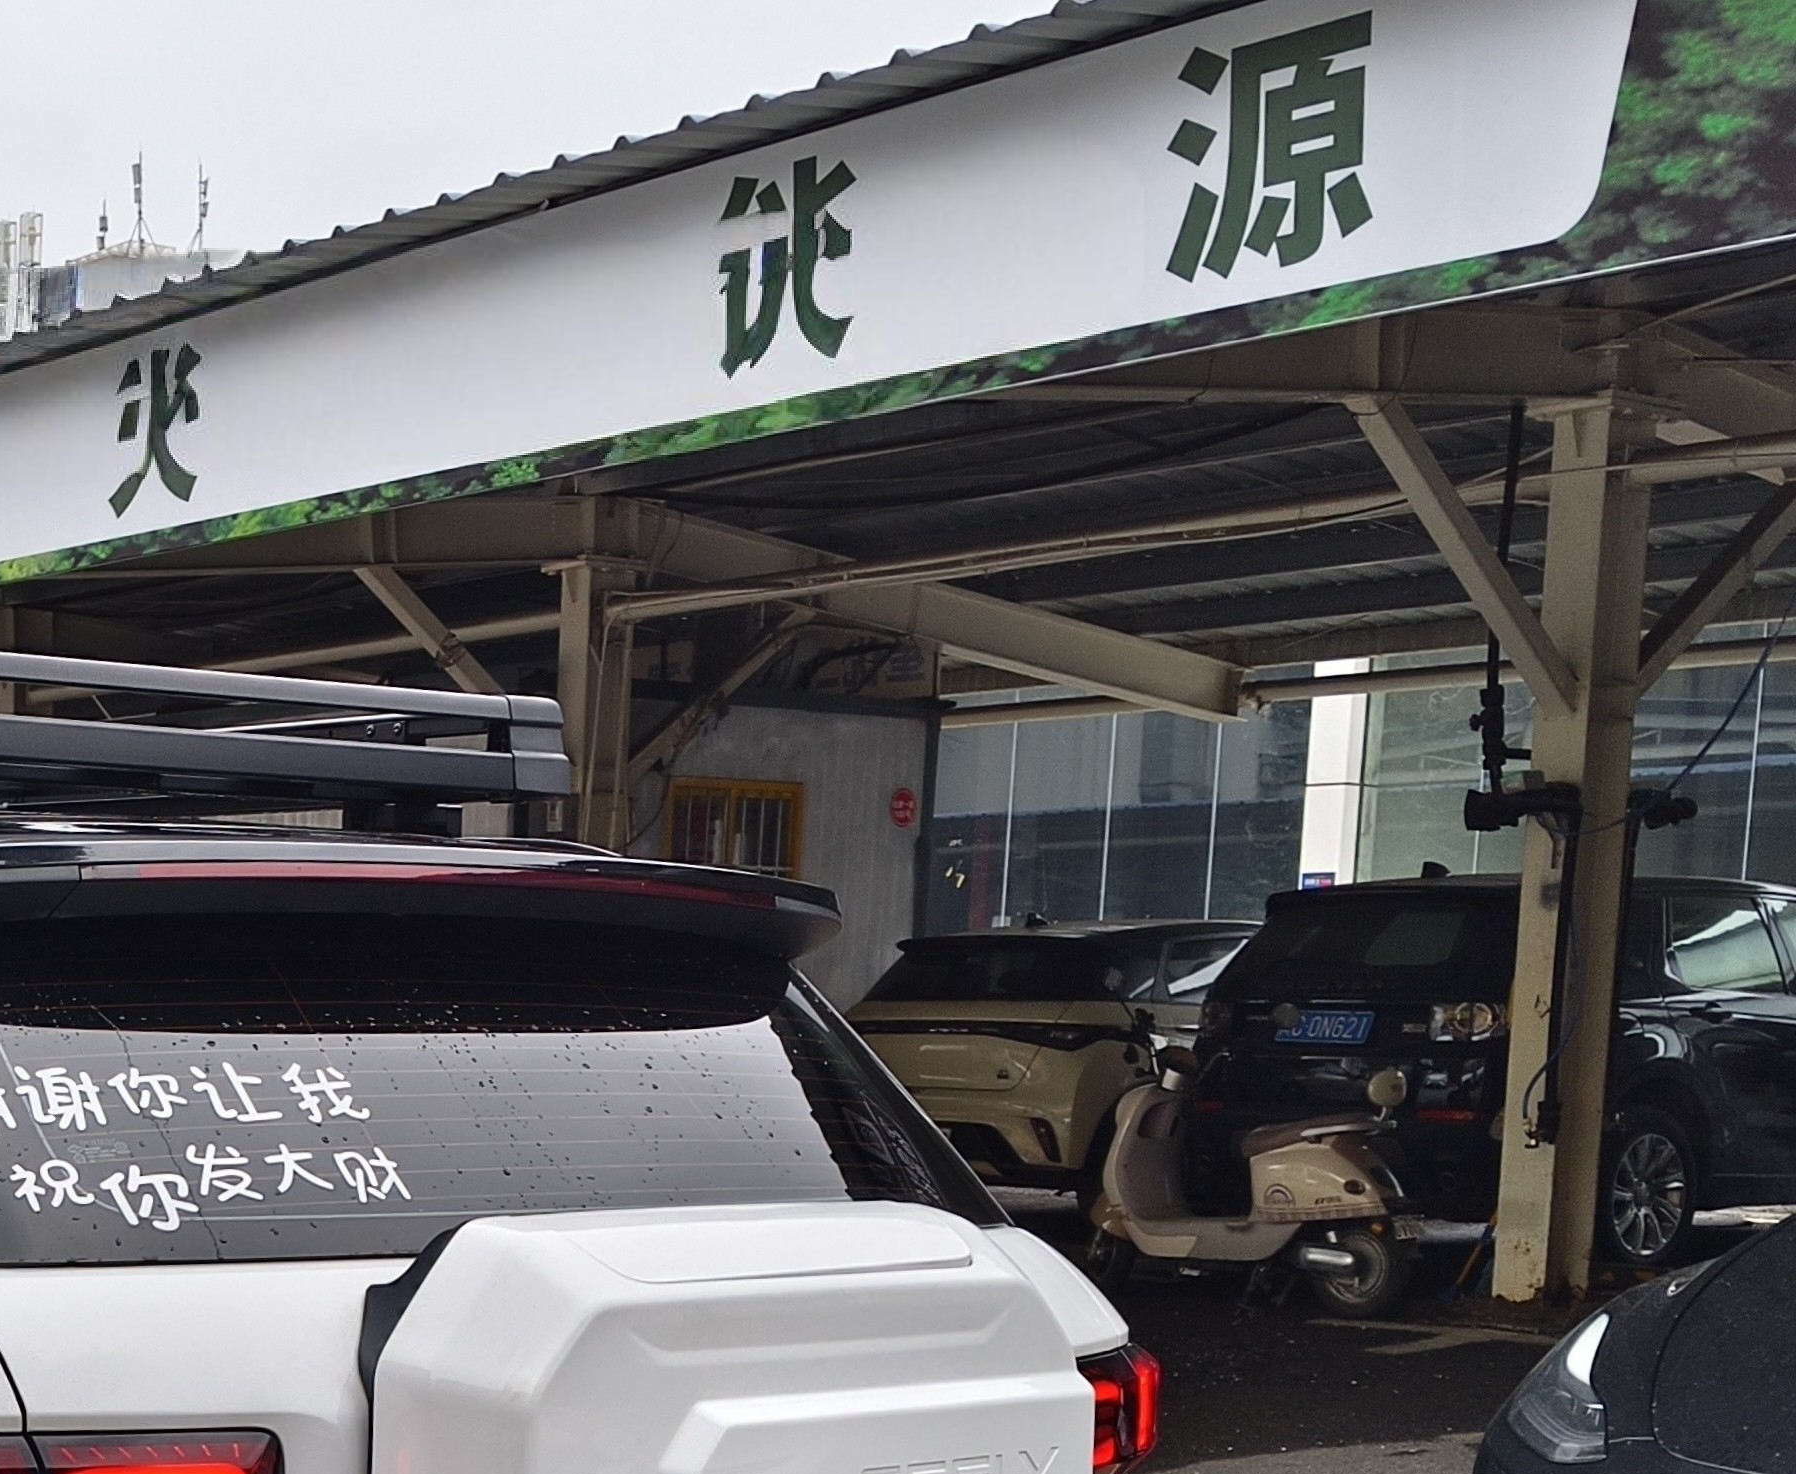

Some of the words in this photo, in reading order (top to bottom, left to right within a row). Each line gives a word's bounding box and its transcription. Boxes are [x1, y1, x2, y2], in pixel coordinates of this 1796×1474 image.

[9, 1143, 412, 1232] 祝你发大财
